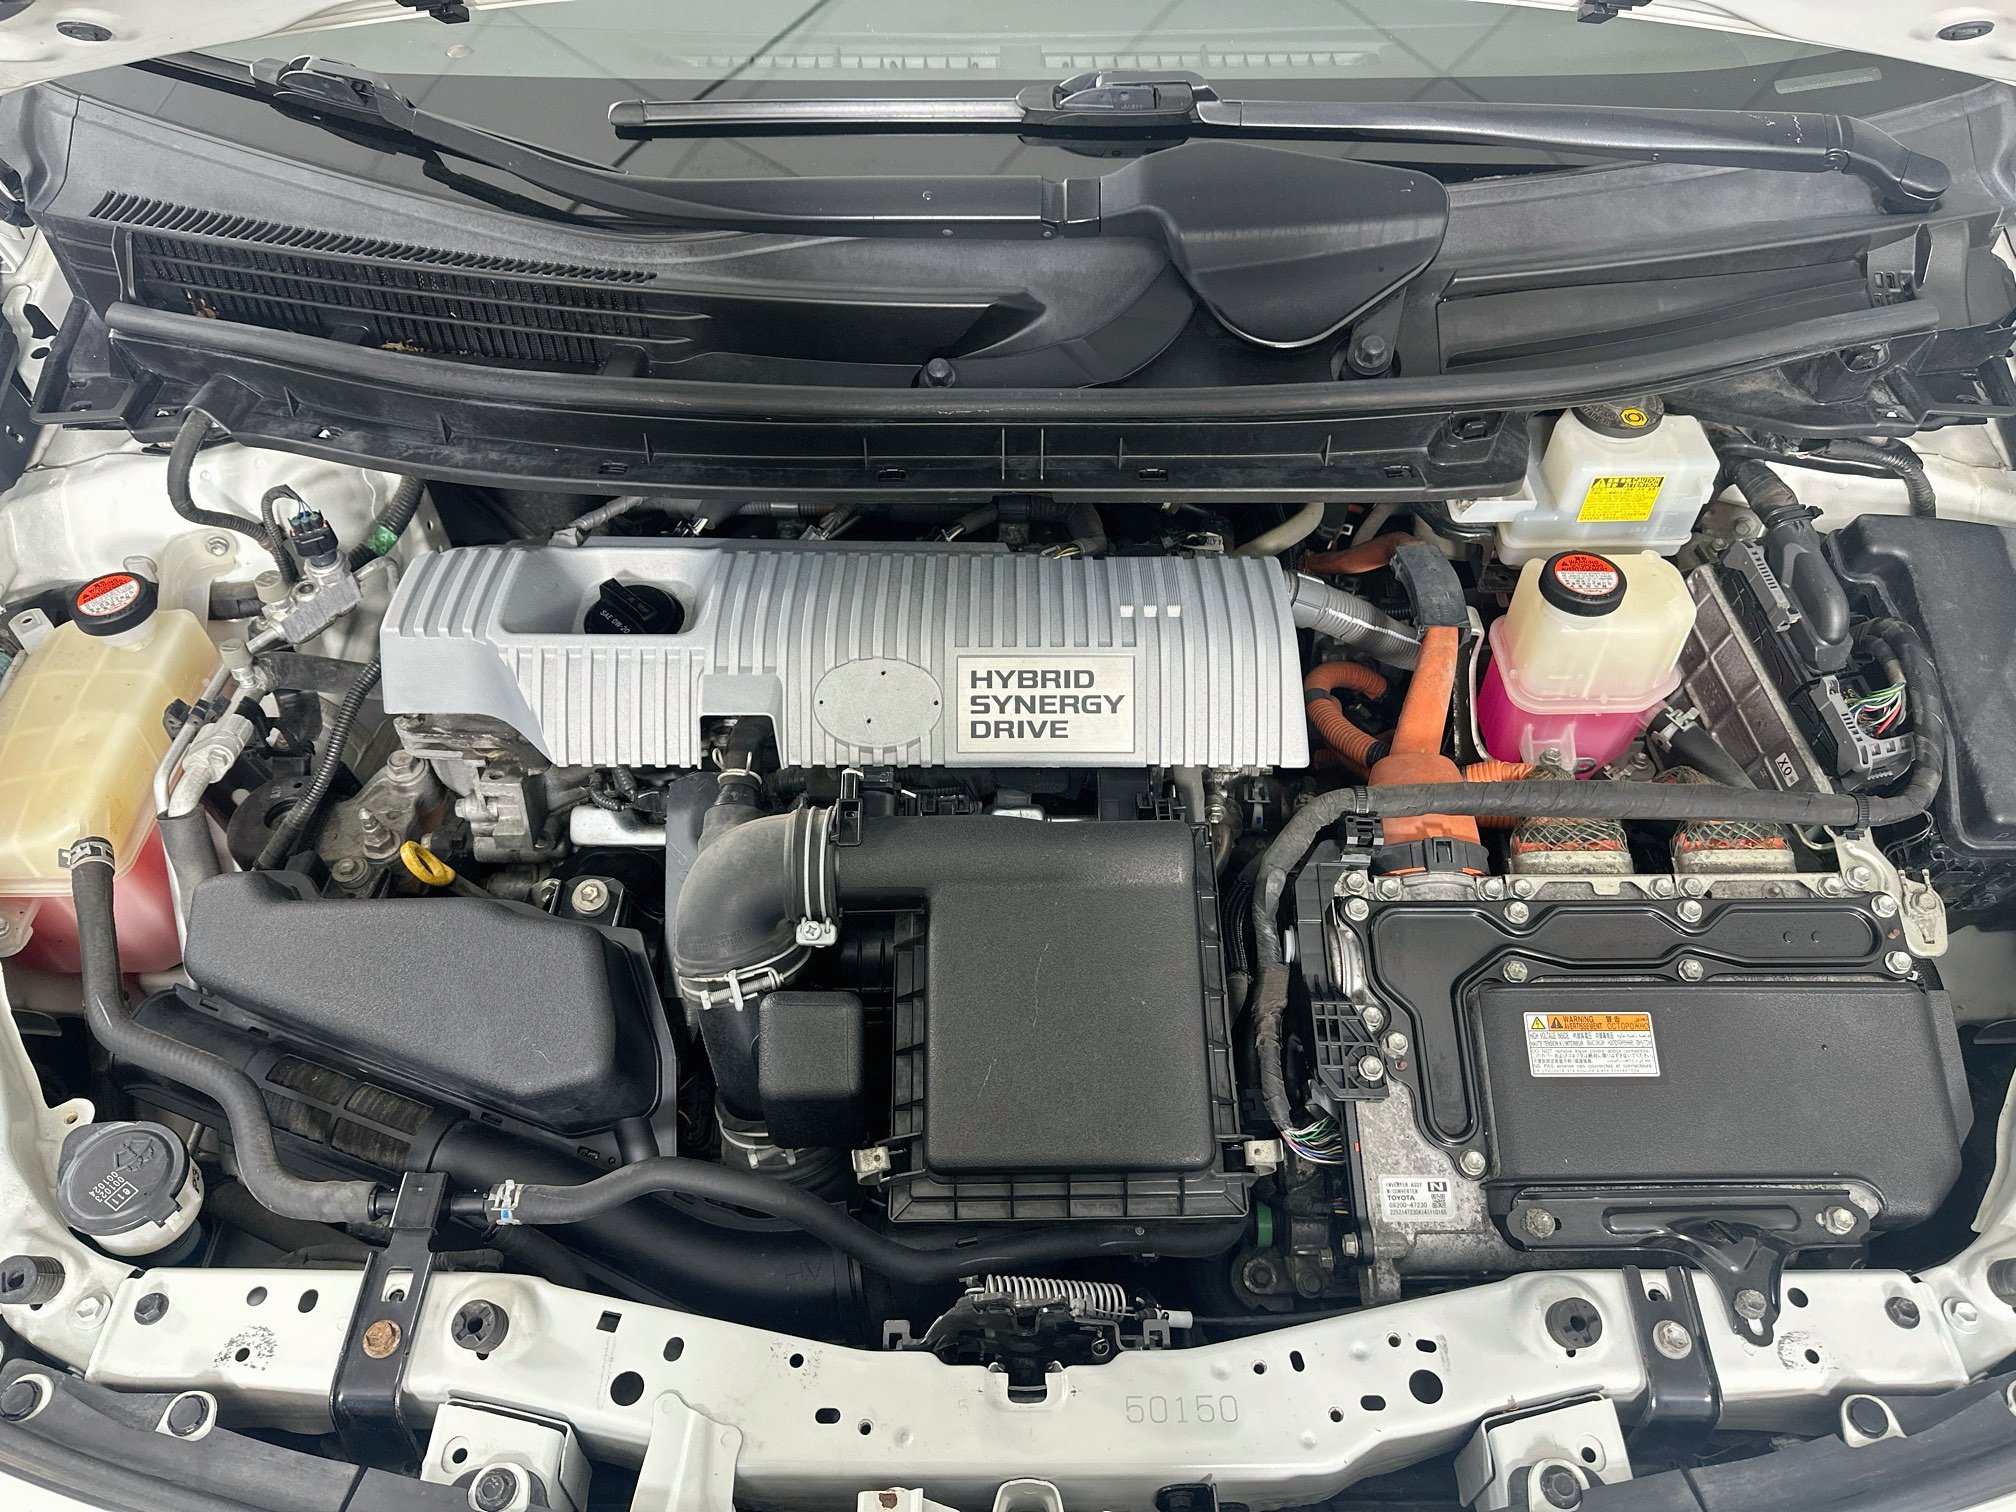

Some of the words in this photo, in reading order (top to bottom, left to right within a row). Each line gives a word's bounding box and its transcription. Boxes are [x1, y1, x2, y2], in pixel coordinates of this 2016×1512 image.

[600, 609, 613, 621] SAE
[970, 670, 1095, 689] HYBRID
[970, 695, 1126, 714] SYNERGY
[970, 720, 1069, 739] DRIVE
[1563, 1015, 1594, 1023] WARNING
[88, 1171, 119, 1198] 001024
[94, 1176, 125, 1203] 001023
[111, 1187, 131, 1205] e11
[1125, 1395, 1239, 1424] 50150
